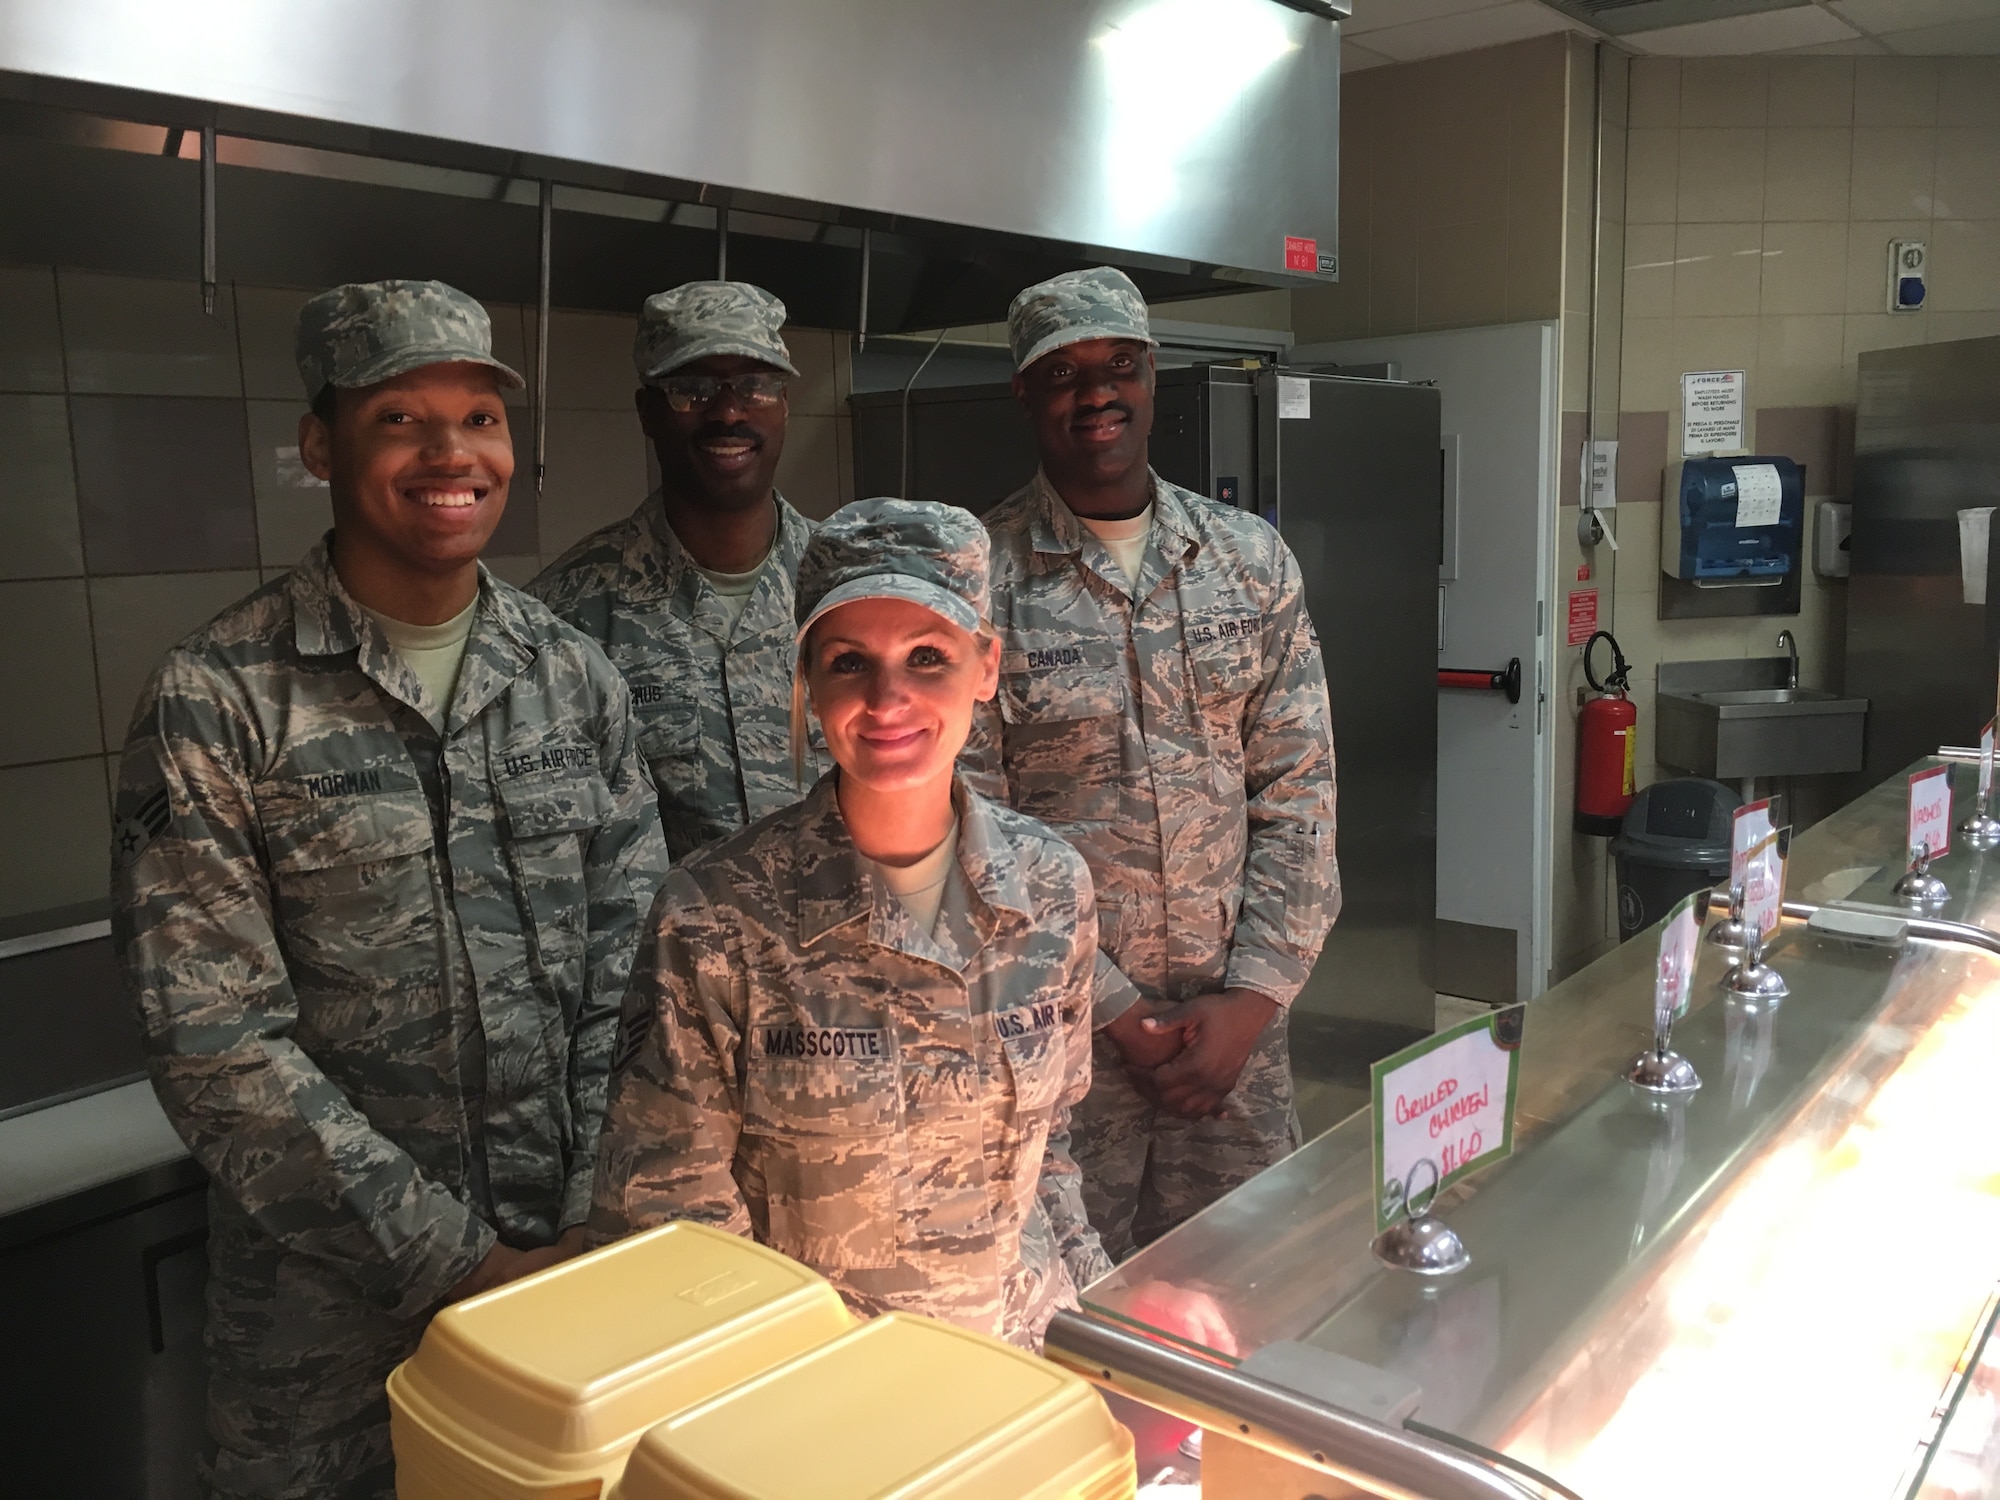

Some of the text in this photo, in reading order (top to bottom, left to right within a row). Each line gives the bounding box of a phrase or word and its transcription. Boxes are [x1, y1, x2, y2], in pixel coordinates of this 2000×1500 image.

[1192, 627, 1216, 643] U.S.
[1218, 621, 1238, 639] AIR
[1028, 649, 1082, 668] CANADA
[504, 754, 539, 775] U.S.
[541, 748, 566, 770] AIR
[308, 769, 381, 798] MORMAN
[996, 1013, 1029, 1038] U.S.
[1032, 1004, 1055, 1031] AIR
[766, 1028, 881, 1057] MASSCOTTE
[1395, 1078, 1458, 1124] GRILLED
[1429, 1083, 1489, 1138] CHICKEN
[1441, 1132, 1482, 1178] $1.60
